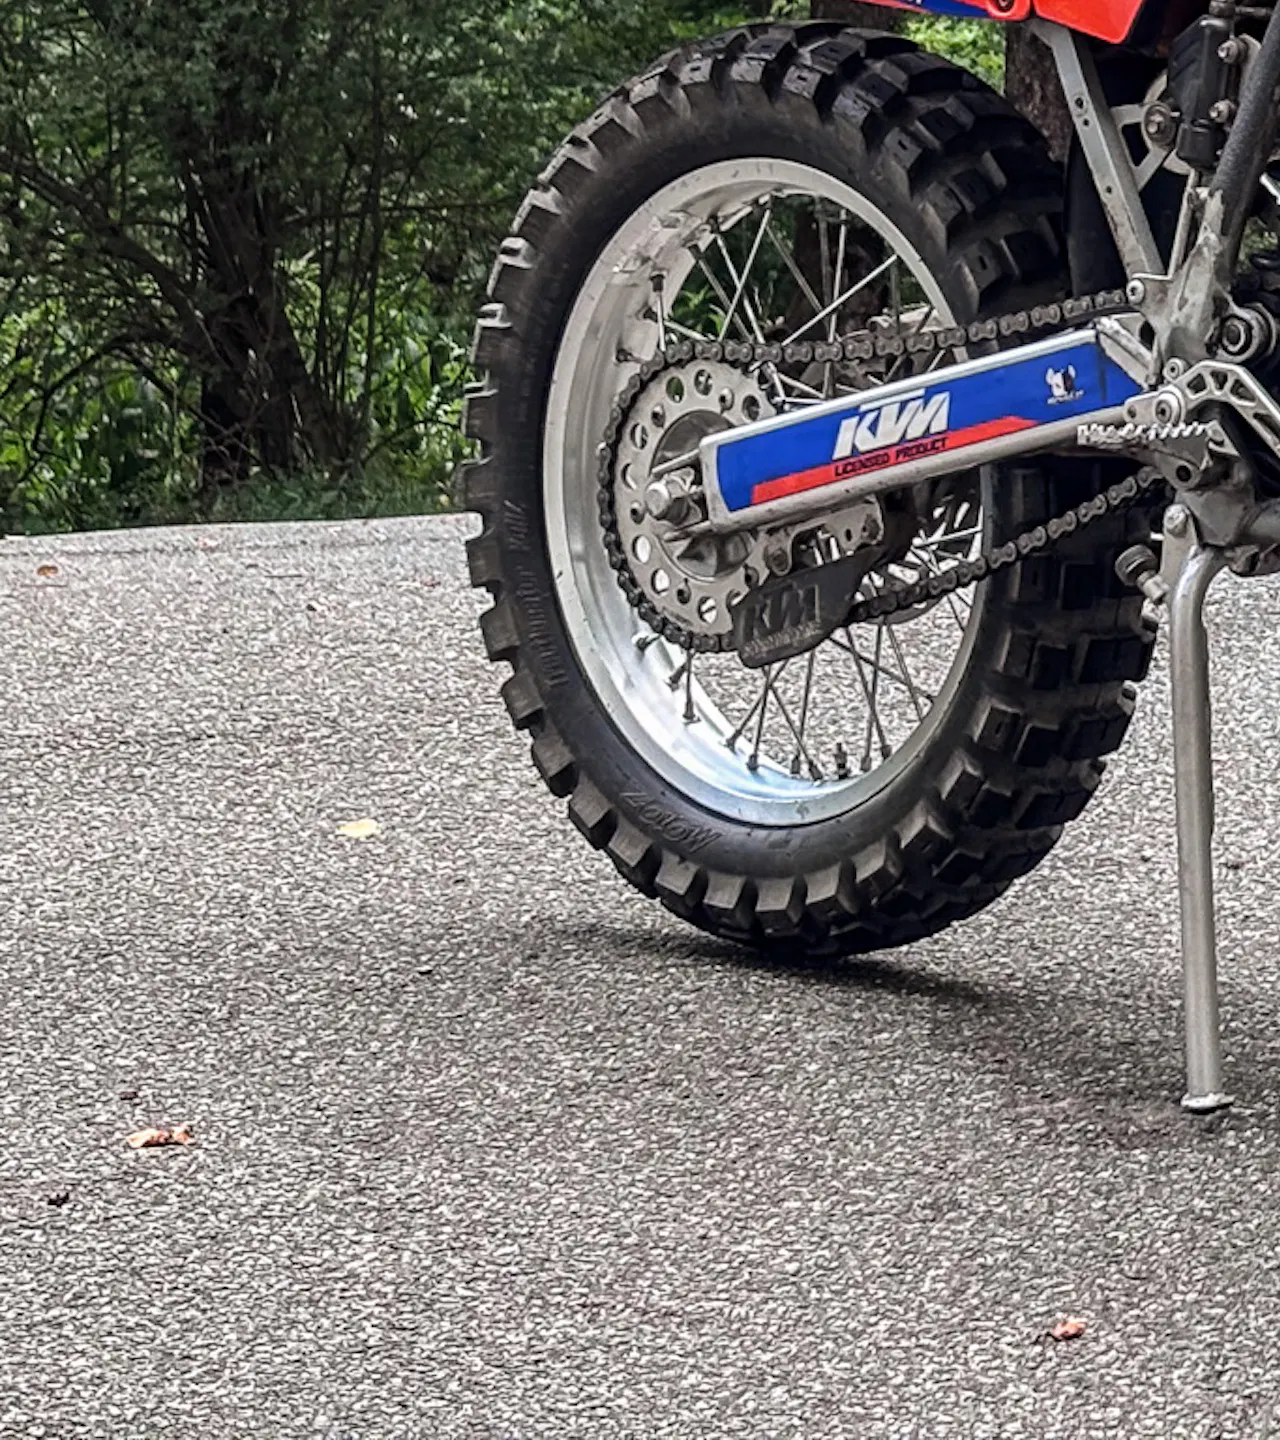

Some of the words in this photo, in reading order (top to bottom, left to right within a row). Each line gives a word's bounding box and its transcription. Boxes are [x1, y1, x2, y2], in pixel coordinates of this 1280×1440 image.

[831, 388, 951, 461] KTM
[834, 452, 891, 477] LICENSED
[895, 436, 949, 460] PRODUCT
